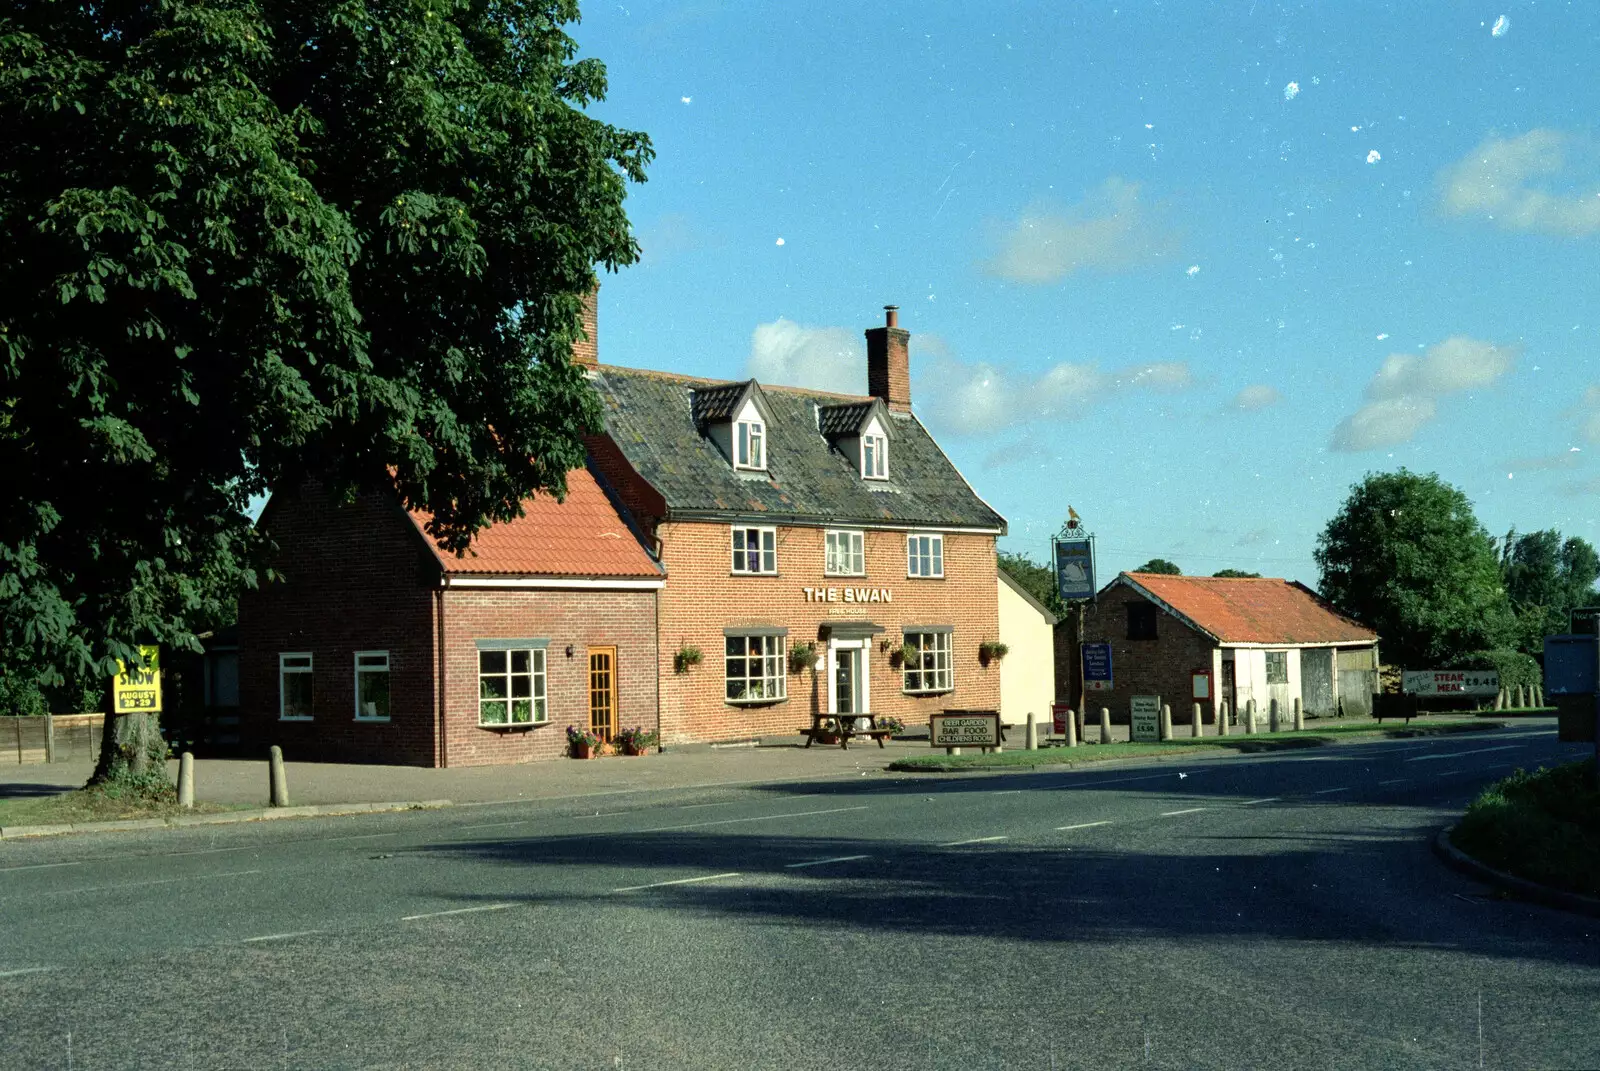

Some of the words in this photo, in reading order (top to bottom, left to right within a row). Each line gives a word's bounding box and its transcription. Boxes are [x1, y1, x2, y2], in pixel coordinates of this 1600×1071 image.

[802, 587, 837, 602] THE
[843, 587, 893, 603] SWAN
[120, 672, 154, 685] SHOW
[1434, 673, 1464, 682] STEAK
[120, 691, 155, 700] AUGUST
[960, 719, 987, 727] GARDEN
[942, 727, 959, 735] BAR
[938, 735, 972, 743] CHILDRENS
